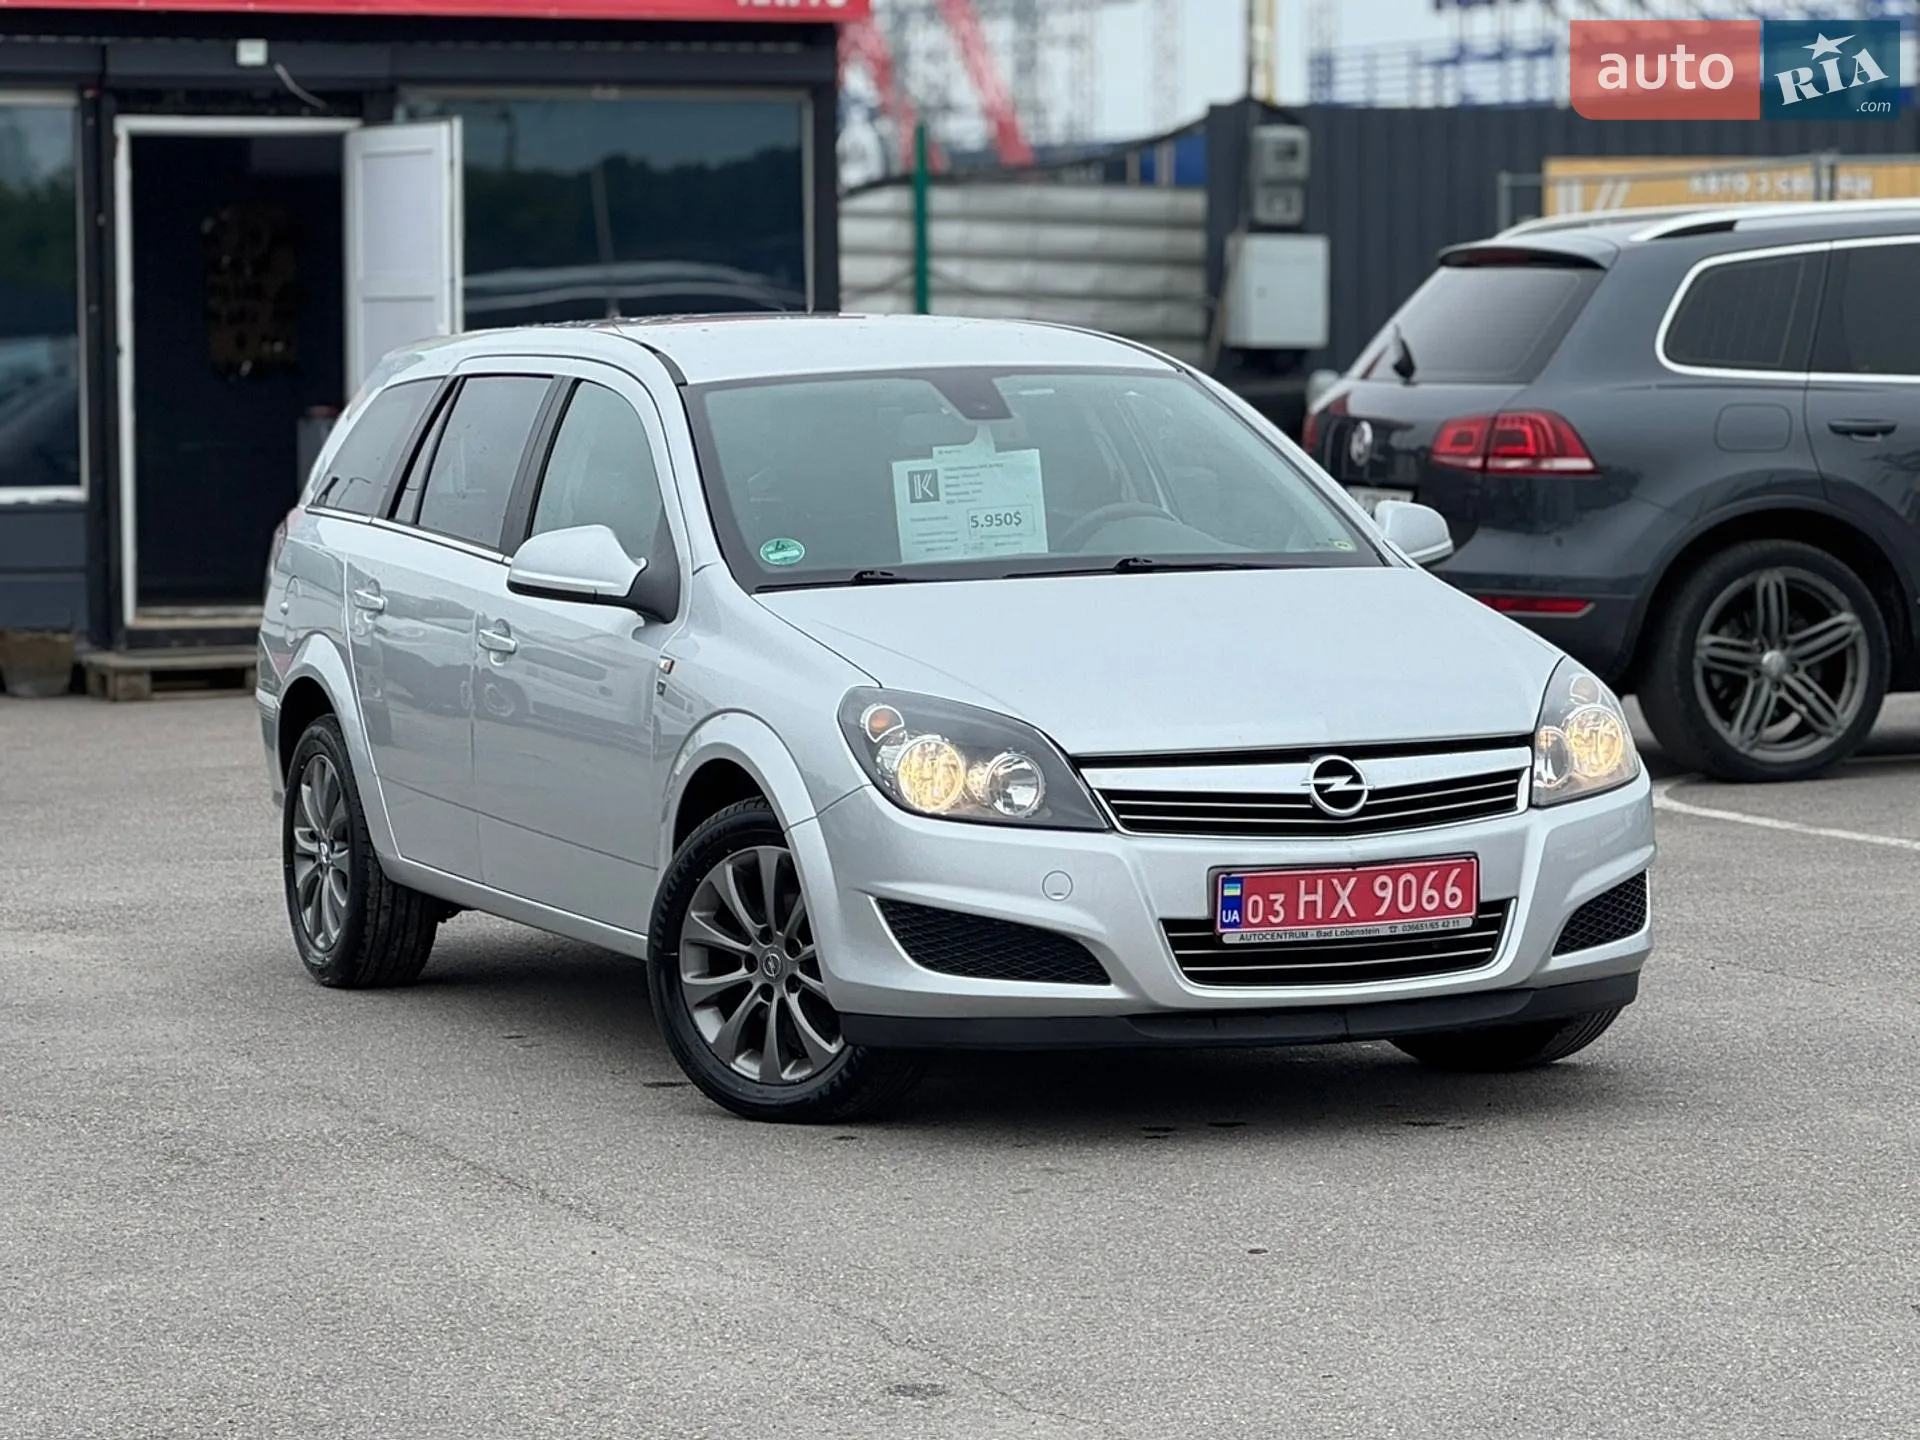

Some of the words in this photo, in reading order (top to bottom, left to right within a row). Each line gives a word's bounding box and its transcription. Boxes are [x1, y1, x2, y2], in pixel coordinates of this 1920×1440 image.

[970, 511, 1023, 529] 5.950$
[1247, 894, 1286, 924] 03
[1297, 877, 1357, 920] HX
[1373, 868, 1464, 917] 9066
[1222, 909, 1240, 923] UA
[1239, 931, 1309, 942] AUTOCENTRUM
[1316, 930, 1333, 938] Bad
[1334, 926, 1380, 937] Lobenstein
